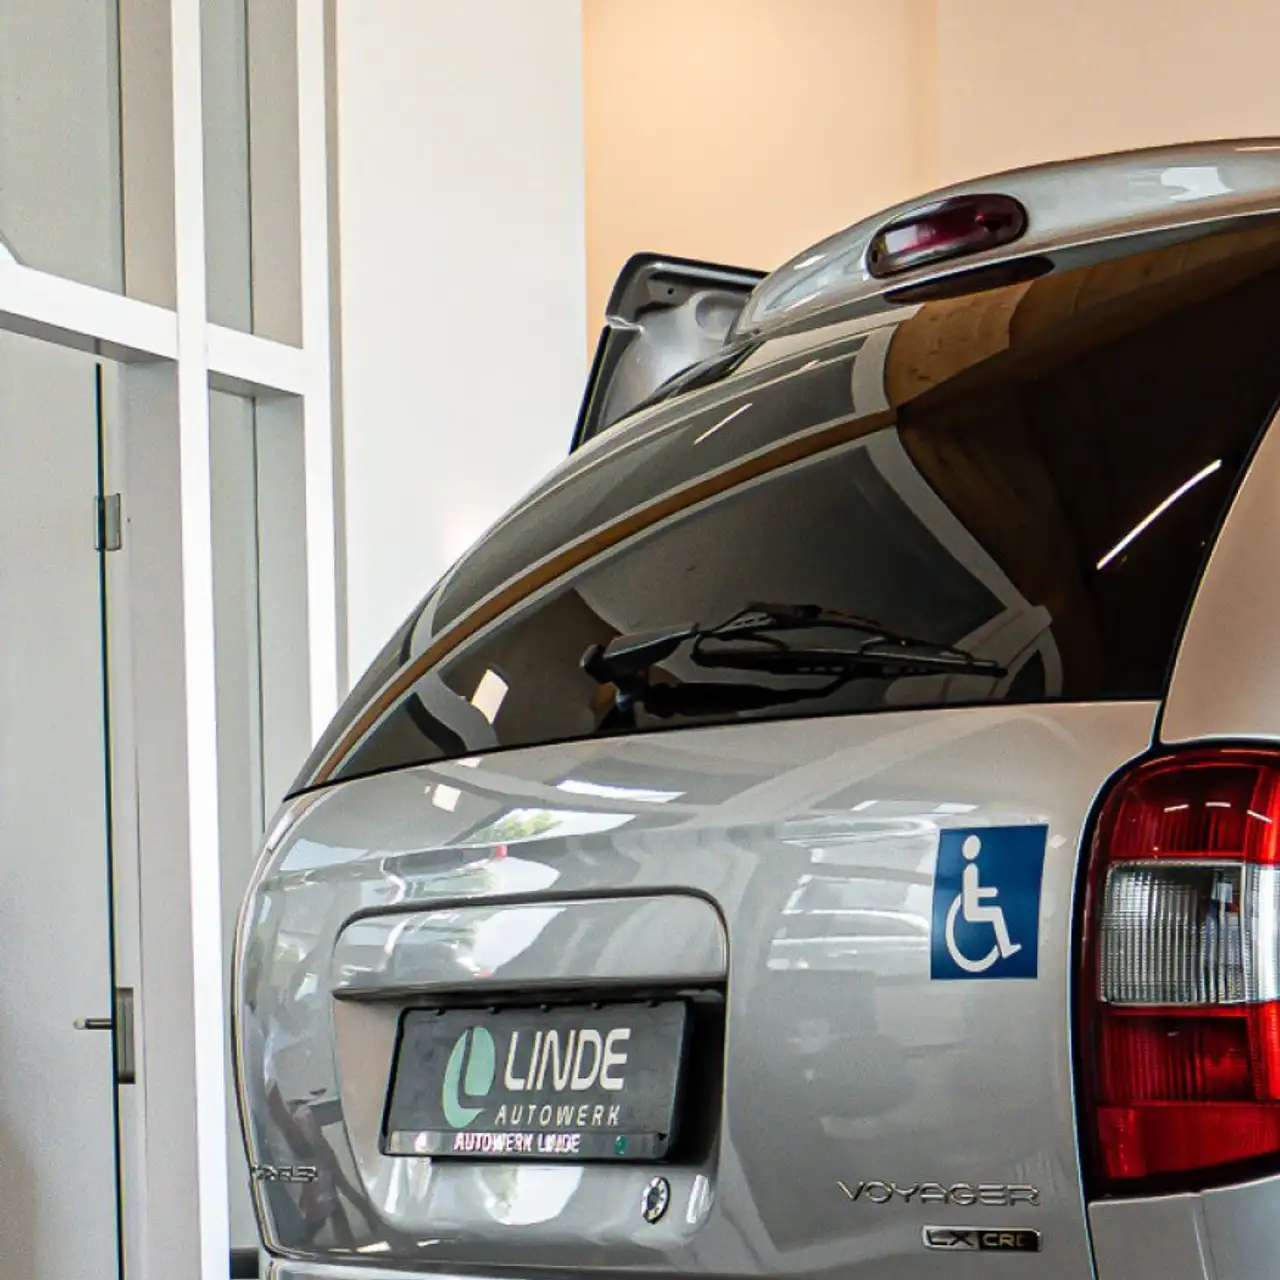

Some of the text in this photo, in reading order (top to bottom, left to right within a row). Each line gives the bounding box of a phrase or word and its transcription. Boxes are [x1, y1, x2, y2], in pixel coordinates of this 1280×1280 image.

[504, 1027, 631, 1092] LINDE
[494, 1104, 621, 1127] AUTOWERK
[453, 1131, 582, 1153] AUTOWERK LINDE
[837, 1180, 1040, 1206] VOYAGER
[926, 1229, 973, 1247] LX
